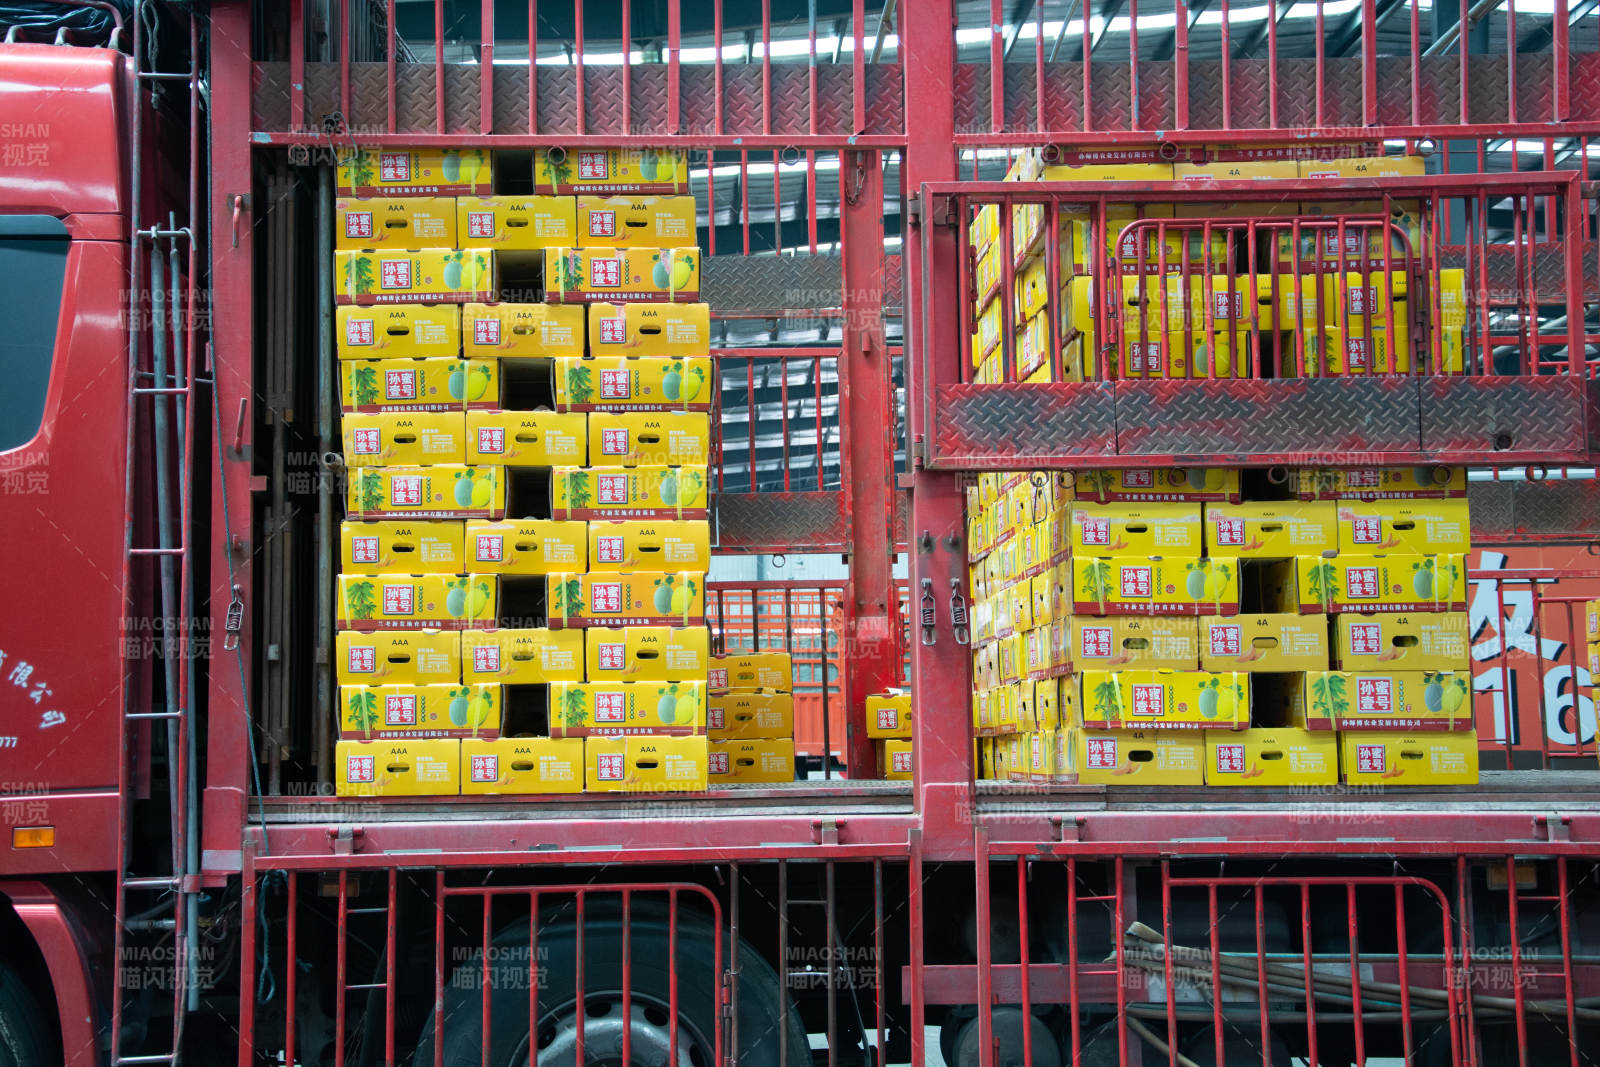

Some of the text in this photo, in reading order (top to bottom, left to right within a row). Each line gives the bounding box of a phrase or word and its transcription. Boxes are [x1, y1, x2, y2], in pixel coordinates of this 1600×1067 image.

[580, 152, 606, 164] 孙蜜
[580, 164, 606, 177] 壹号
[1228, 168, 1240, 176] 4A
[1356, 164, 1368, 172] 4A
[388, 204, 404, 212] AAA
[510, 204, 526, 212] AAA
[470, 214, 493, 224] 孙蜜
[470, 224, 493, 235] 壹号
[383, 262, 409, 274] 孙蜜
[383, 274, 409, 287] 壹号
[642, 310, 658, 318] AAA
[476, 321, 499, 332] 孙蜜
[476, 332, 499, 343] 壹号
[388, 371, 414, 384] 孙蜜
[388, 384, 414, 397] 壹号
[396, 420, 414, 428] AAA
[520, 420, 536, 428] AAA
[356, 430, 379, 441] 孙蜜
[356, 441, 379, 452] 壹号
[393, 479, 419, 491] 孙蜜
[600, 476, 625, 488] 孙蜜
[393, 491, 419, 503] 壹号
[600, 488, 625, 501] 壹号
[394, 528, 412, 536] AAA
[520, 528, 536, 536] AAA
[354, 538, 377, 549] 孙蜜
[600, 538, 622, 549] 孙蜜
[354, 549, 377, 560] 壹号
[600, 549, 622, 560] 壹号
[1123, 568, 1149, 582] 孙蜜
[1349, 569, 1376, 582] 孙蜜
[385, 587, 412, 600] 孙蜜
[594, 585, 619, 598] 孙蜜
[1123, 582, 1149, 595] 壹号
[1349, 582, 1376, 596] 壹号
[385, 600, 412, 612] 壹号
[594, 598, 619, 610] 壹号
[1128, 622, 1140, 630] 4A
[1256, 618, 1268, 626] 4A
[1396, 616, 1408, 624] 4A
[1083, 629, 1111, 642] 孙蜜
[1352, 625, 1380, 638] 孙蜜
[600, 645, 623, 656] 孙蜜
[1083, 642, 1111, 656] 壹号
[1352, 638, 1380, 652] 壹号
[600, 656, 623, 667] 壹号
[1134, 686, 1162, 700] 孙蜜
[1359, 680, 1391, 695] 孙蜜
[388, 697, 414, 710] 孙蜜
[597, 694, 623, 706] 孙蜜
[1359, 695, 1391, 710] 壹号
[1474, 665, 1597, 745] 16
[597, 706, 623, 719] 壹号
[1134, 700, 1162, 713] 壹号
[388, 710, 414, 723] 壹号
[1132, 732, 1146, 740] 4A
[640, 746, 656, 754] AAA
[1088, 740, 1115, 753] 孙蜜
[1219, 746, 1243, 758] 孙蜜
[473, 757, 496, 768] 孙蜜
[1088, 753, 1115, 766] 壹号
[1219, 758, 1243, 770] 壹号
[473, 768, 496, 779] 壹号
